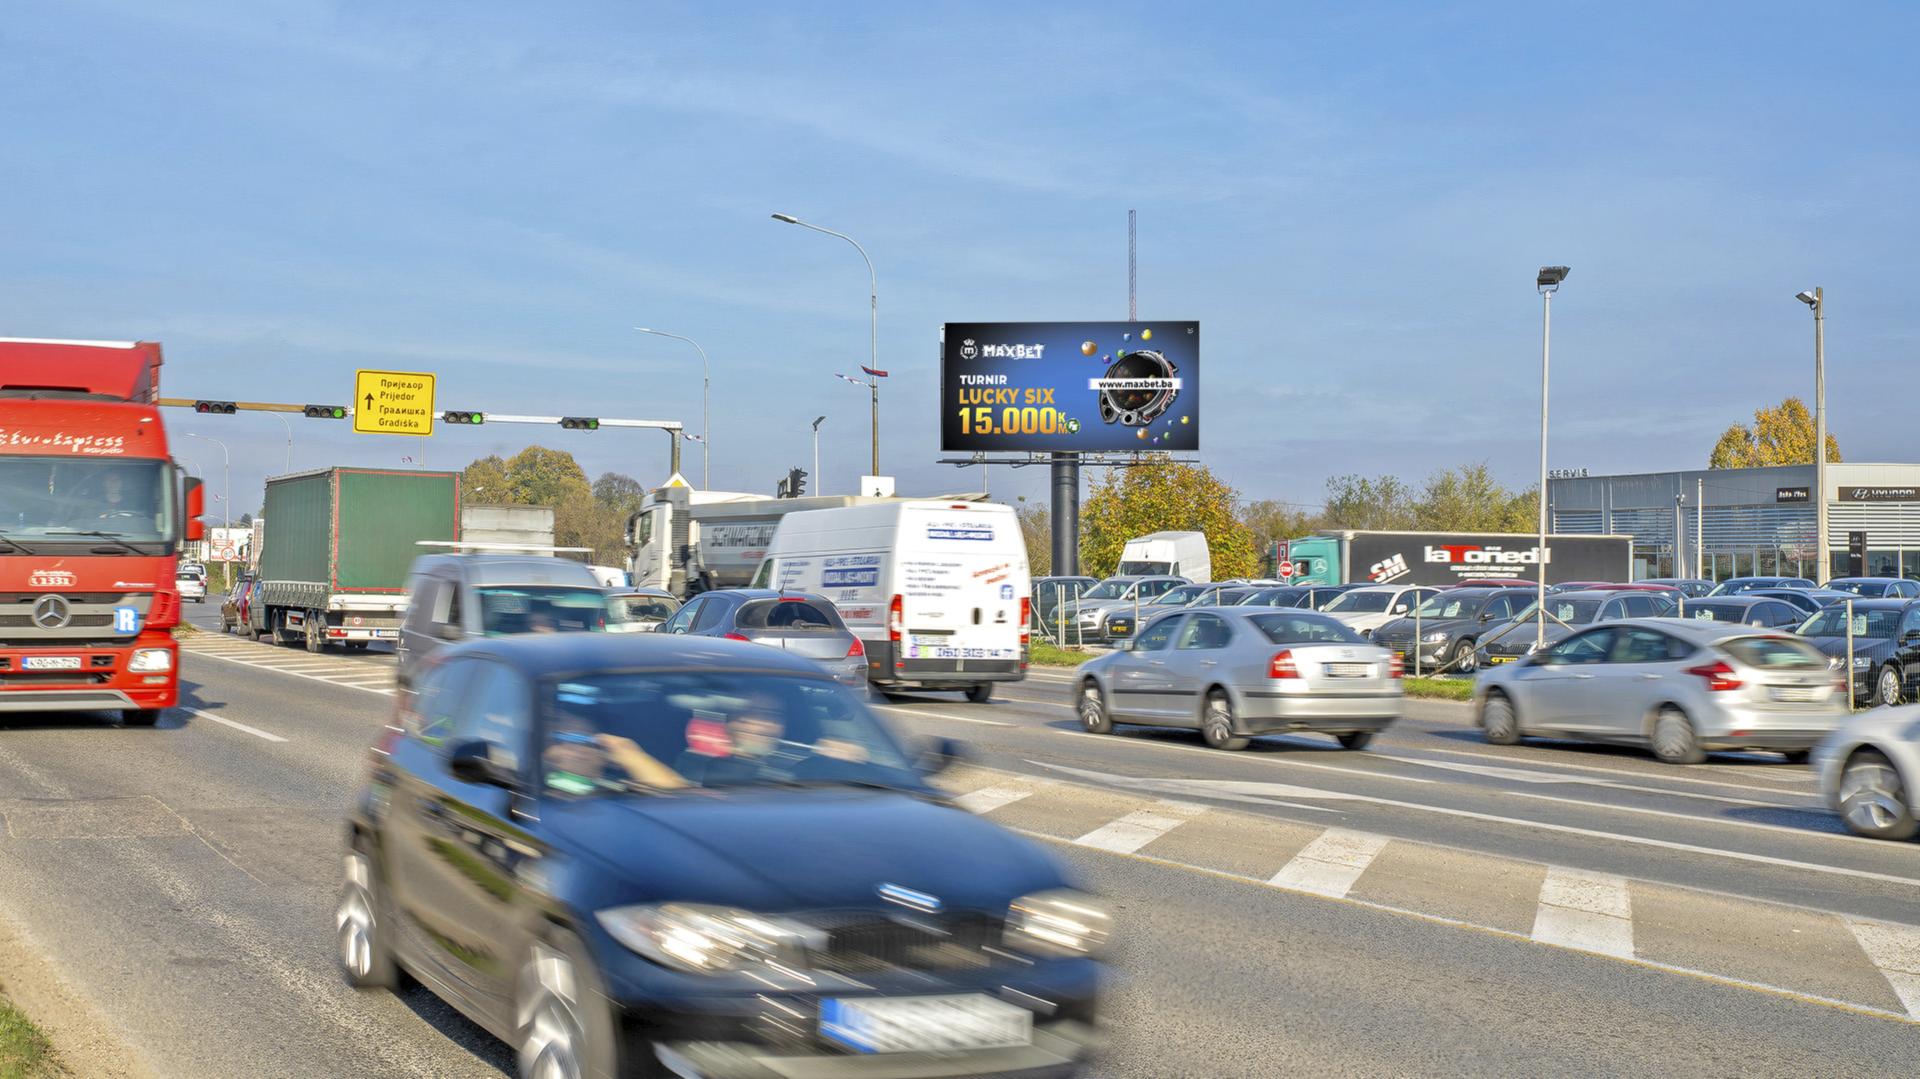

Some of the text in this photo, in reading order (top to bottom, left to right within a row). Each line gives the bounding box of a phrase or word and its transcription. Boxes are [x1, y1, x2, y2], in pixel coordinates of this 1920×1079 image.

[982, 344, 1045, 359] MAXBET
[381, 379, 423, 390] Приједор
[960, 375, 1007, 385] TURNIR
[1099, 380, 1173, 388] www.maxbet.ba
[380, 391, 415, 401] Prijedor
[959, 388, 1055, 404] LUCKY SIX
[379, 405, 425, 415] Градишка
[379, 418, 419, 428] Gradiška
[959, 407, 1057, 434] 15.000
[1549, 468, 1588, 479] SERVIS
[1871, 489, 1916, 497] HYUNDAI
[118, 609, 135, 631] R
